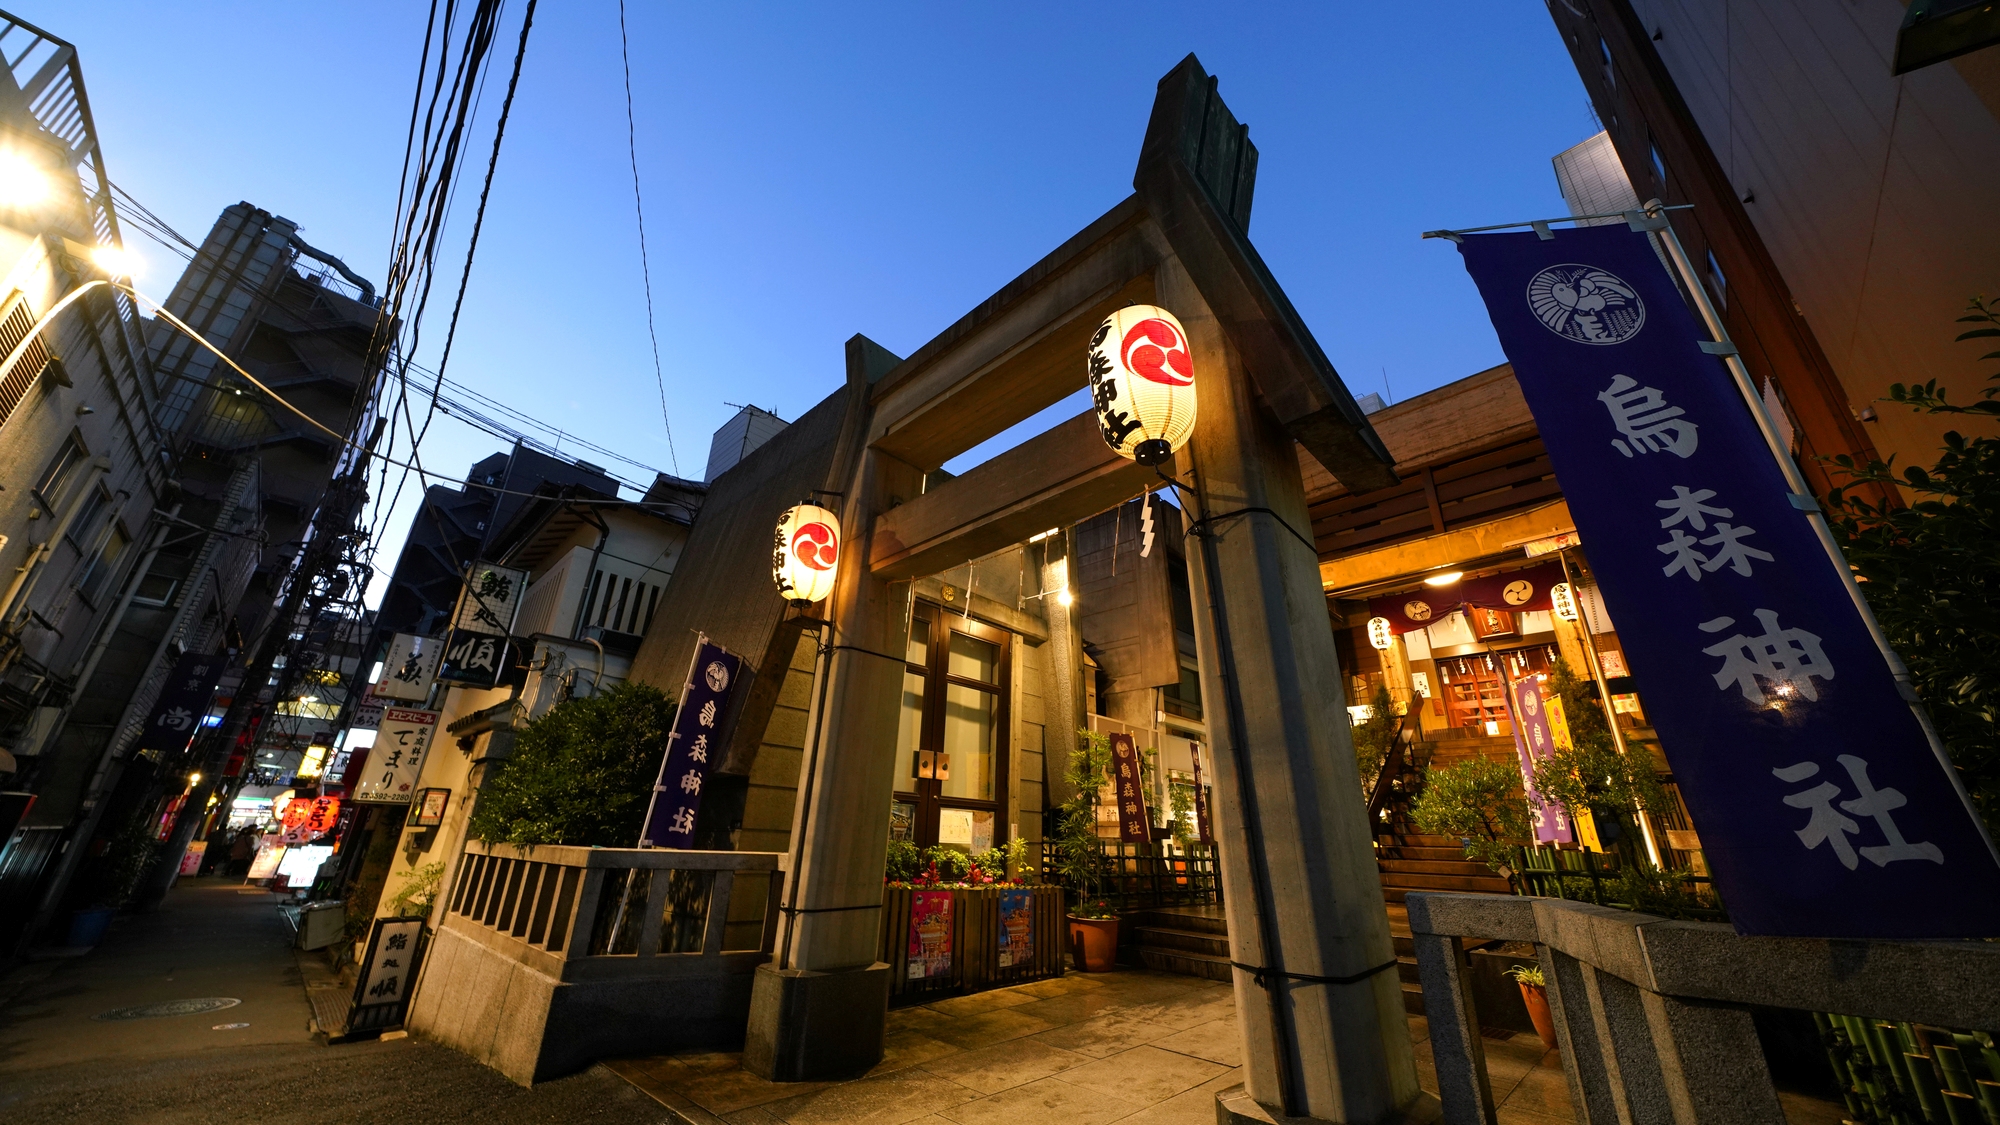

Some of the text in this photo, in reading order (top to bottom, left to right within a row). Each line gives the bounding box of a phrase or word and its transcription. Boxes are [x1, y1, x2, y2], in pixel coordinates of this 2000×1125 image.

[471, 570, 513, 629] 鮨処
[1554, 584, 1576, 617] 烏森神社
[1372, 618, 1387, 645] 烏森神社
[1597, 373, 1944, 871] 烏森神社
[448, 637, 494, 673] 順
[184, 664, 209, 692] 割烹
[157, 706, 193, 731] 尚
[382, 730, 414, 790] てまり
[407, 726, 428, 766] 家庭料理
[308, 798, 331, 828] やきとり
[1120, 763, 1142, 835] 烏森神社
